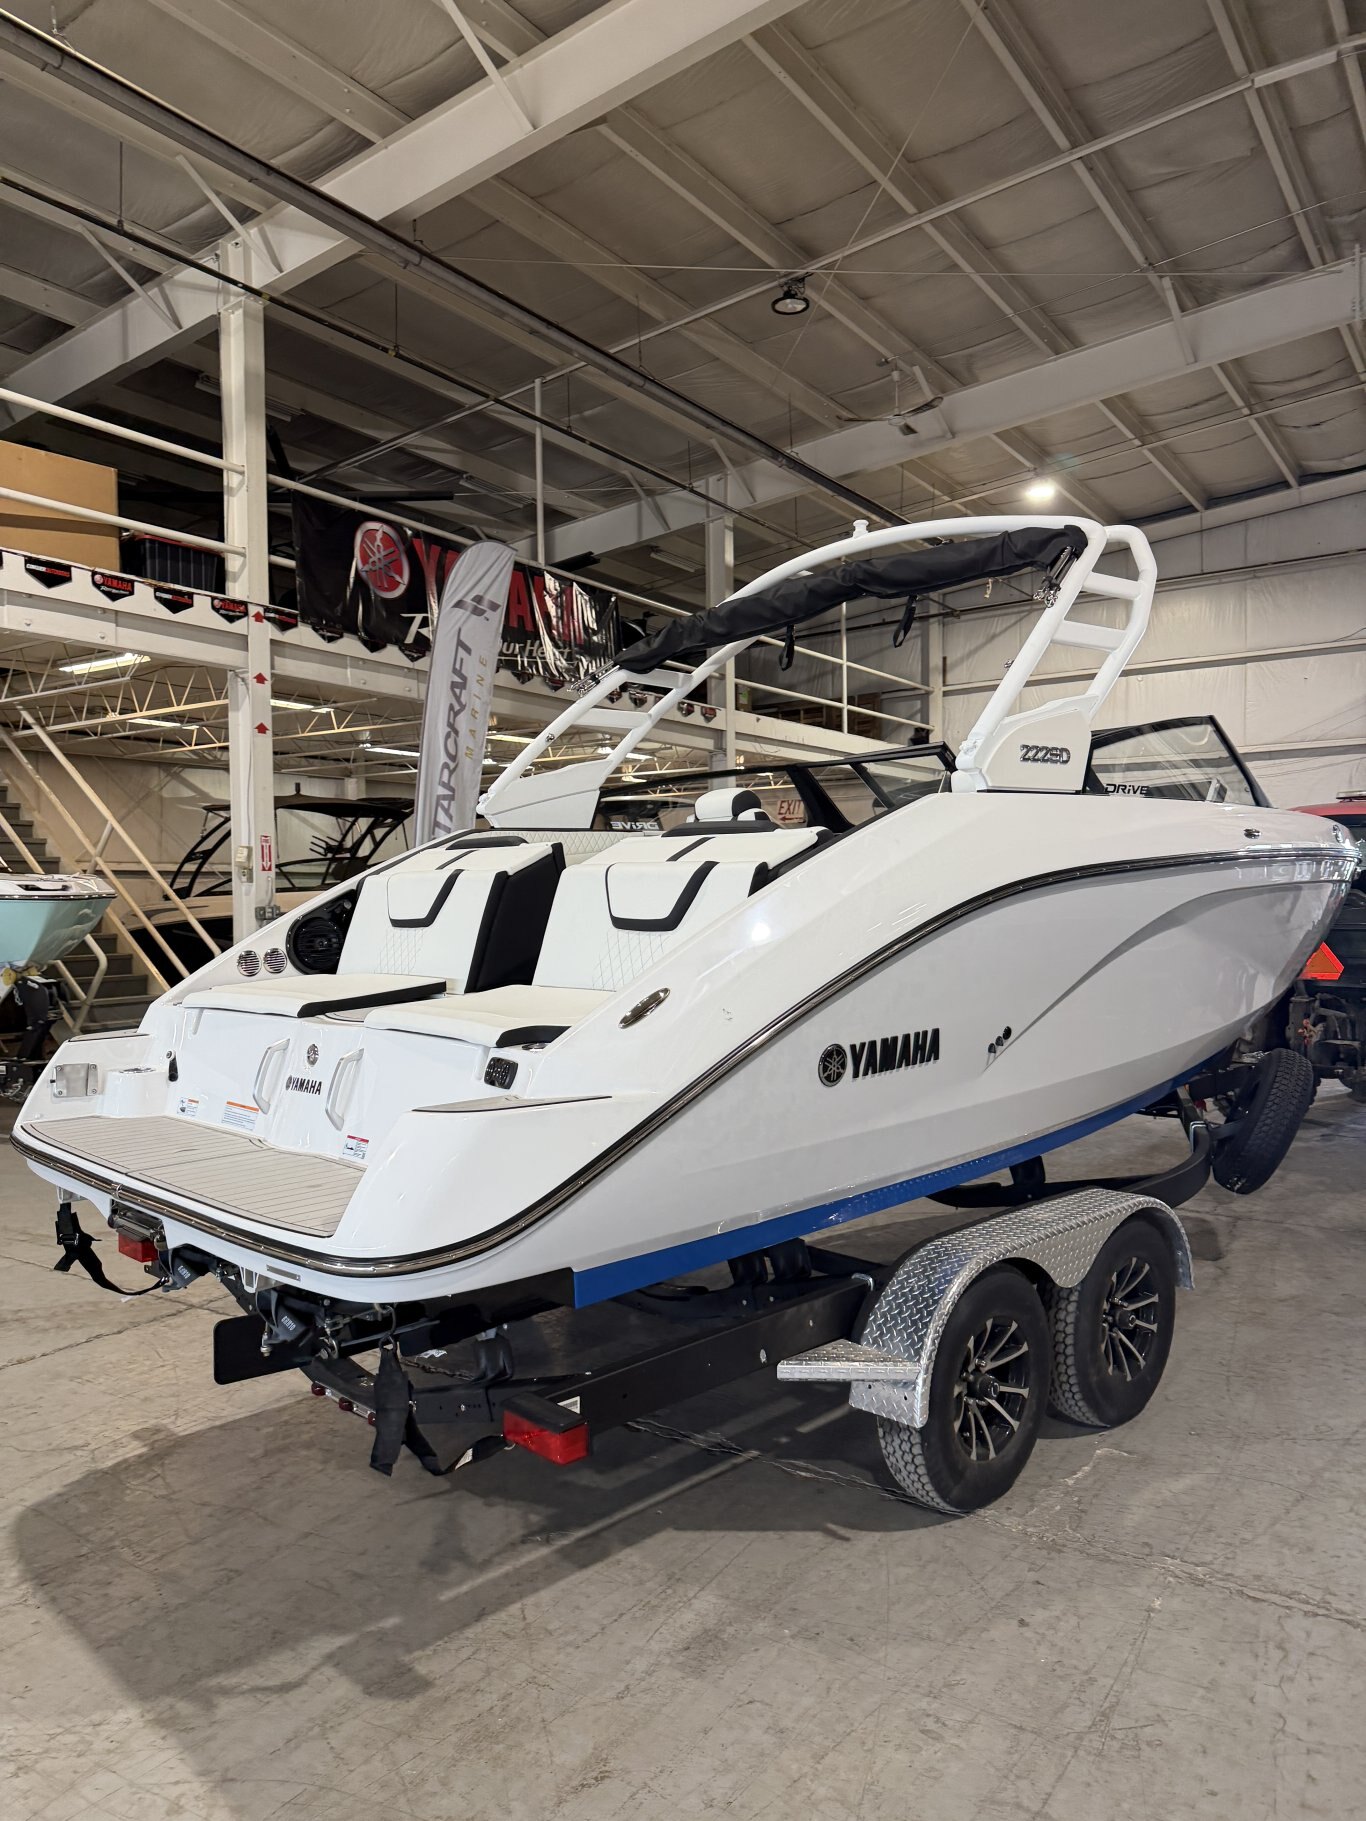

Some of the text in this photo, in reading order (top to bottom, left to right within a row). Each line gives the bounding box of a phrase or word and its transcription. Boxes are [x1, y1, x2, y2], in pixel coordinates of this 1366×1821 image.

[432, 627, 472, 837] TARCRAFT
[464, 654, 488, 760] MARINE
[777, 799, 804, 815] EXIT
[849, 1027, 940, 1079] YAMAHA
[290, 1076, 323, 1096] YAMAHA
